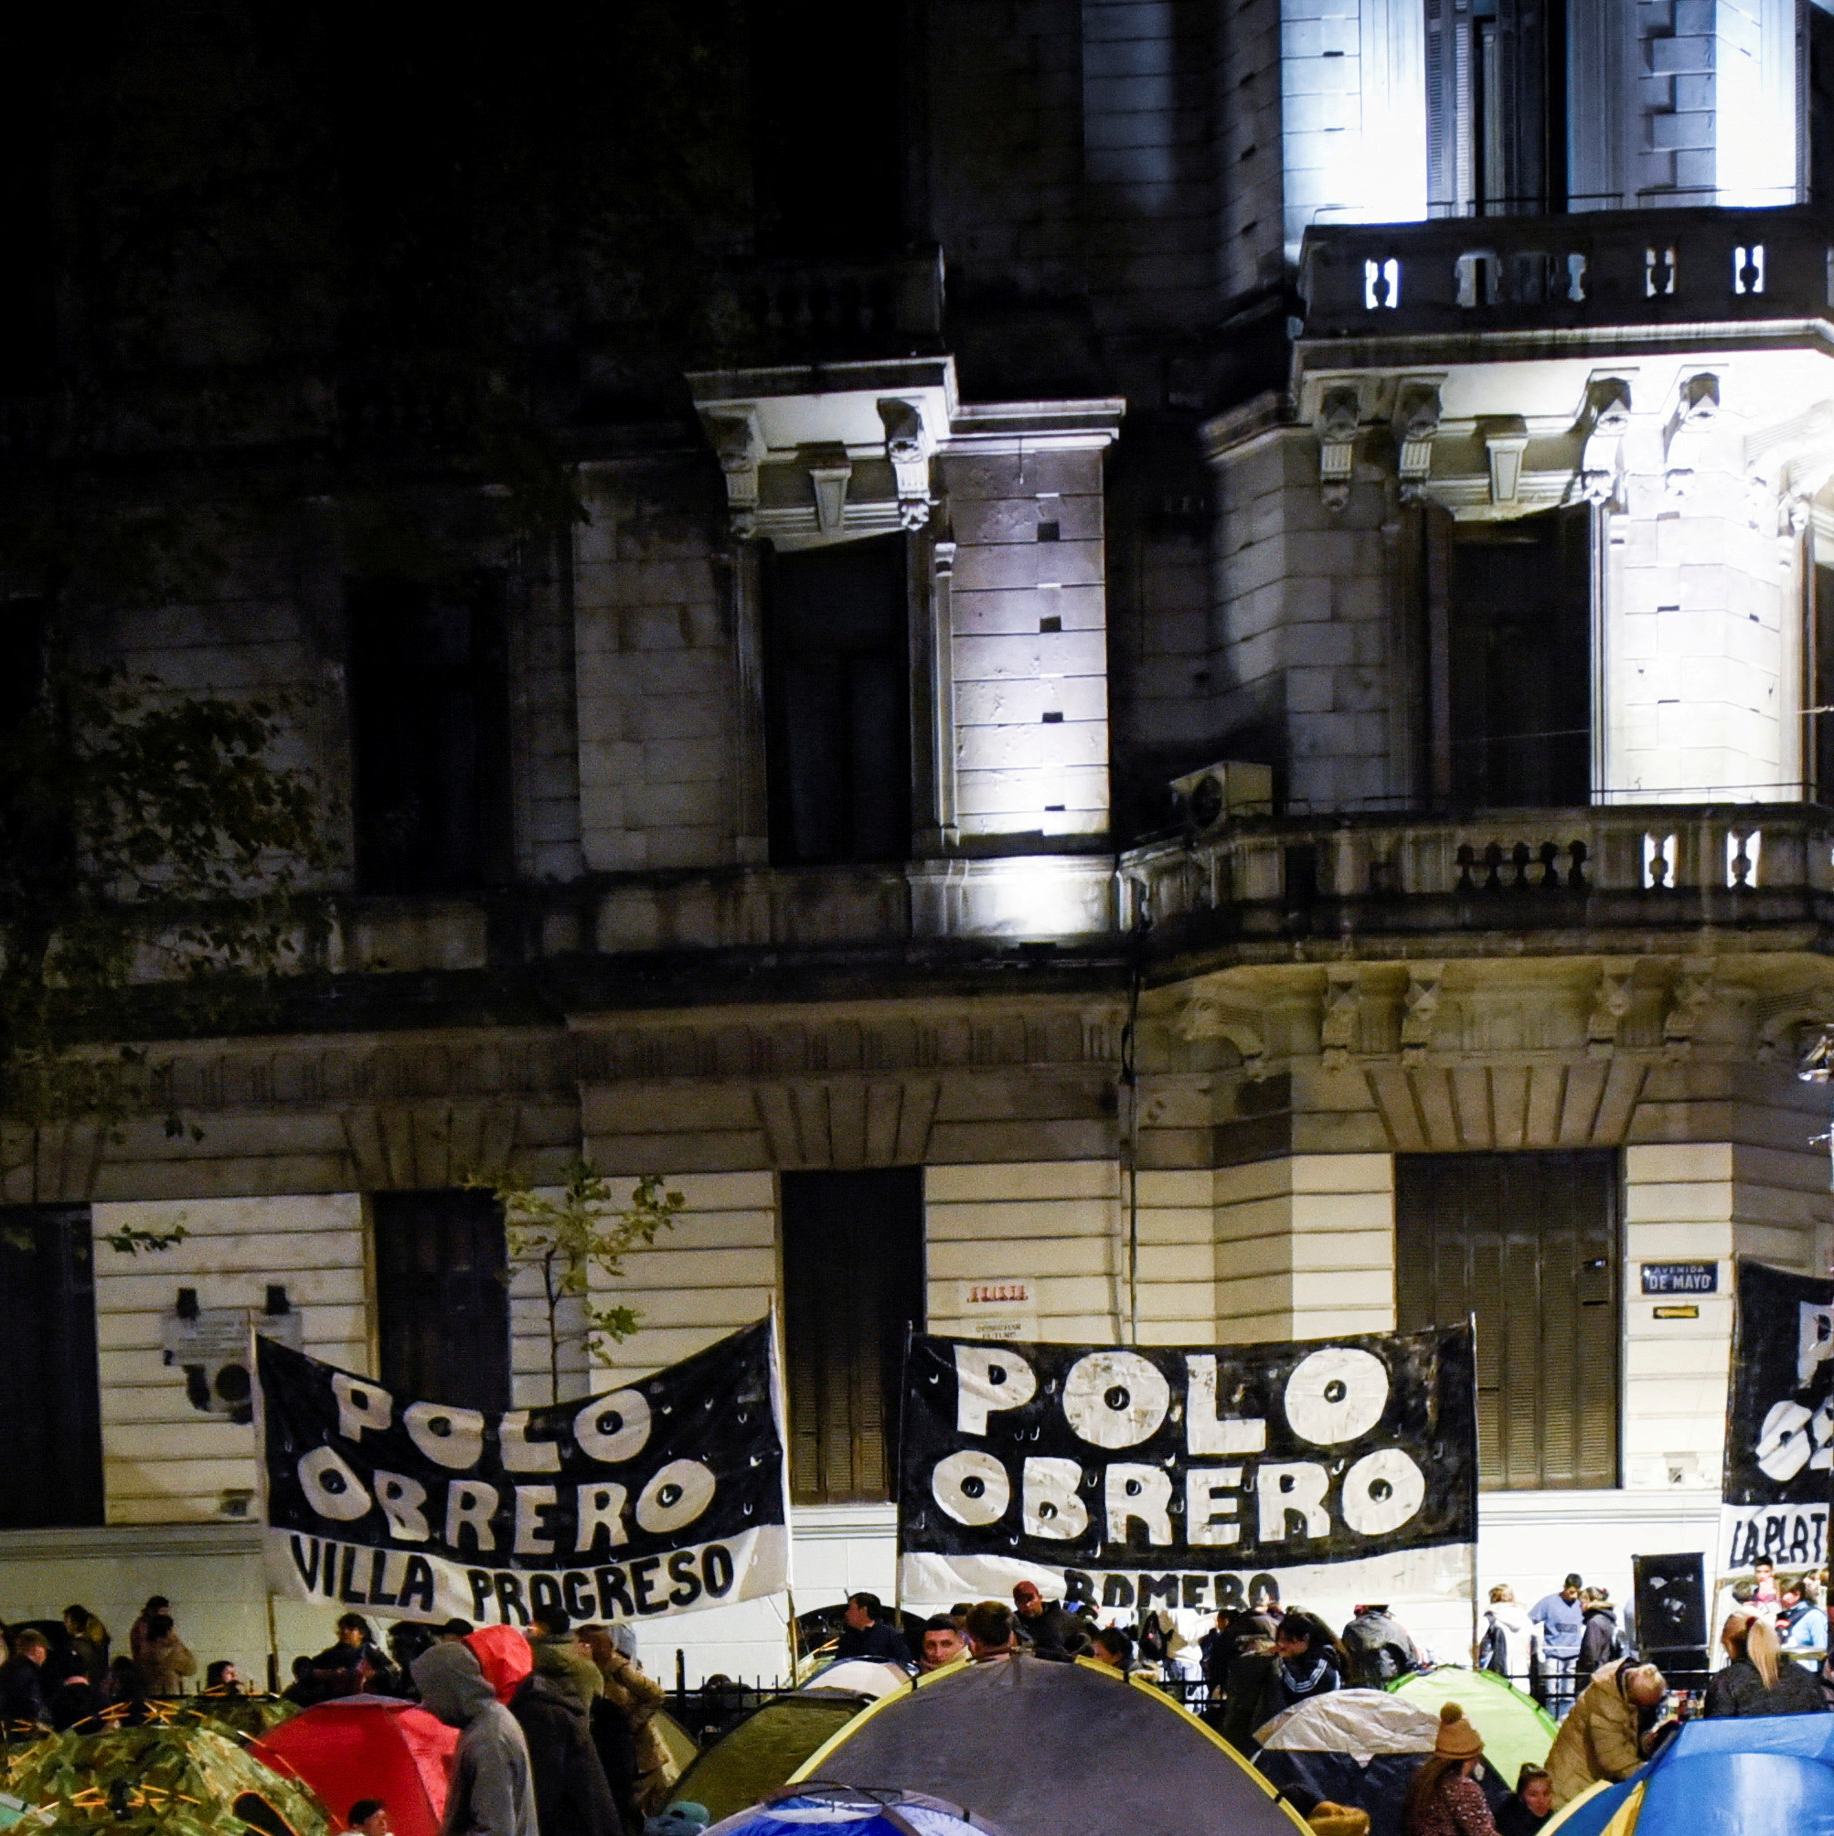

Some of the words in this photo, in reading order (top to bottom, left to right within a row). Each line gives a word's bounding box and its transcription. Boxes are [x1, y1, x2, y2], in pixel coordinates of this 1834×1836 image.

[1649, 1275, 1668, 1290] DE
[1672, 1274, 1711, 1290] MAYO
[331, 1372, 652, 1473] POLO
[953, 1345, 1389, 1456] POLO
[297, 1446, 716, 1556] OBRERO
[932, 1448, 1425, 1547] OBRERO
[1729, 1519, 1760, 1569] LA
[1764, 1512, 1830, 1564] PLAT
[291, 1533, 434, 1613] VILLA
[467, 1544, 734, 1628] PROGRESO
[1064, 1569, 1280, 1615] ROMERO
